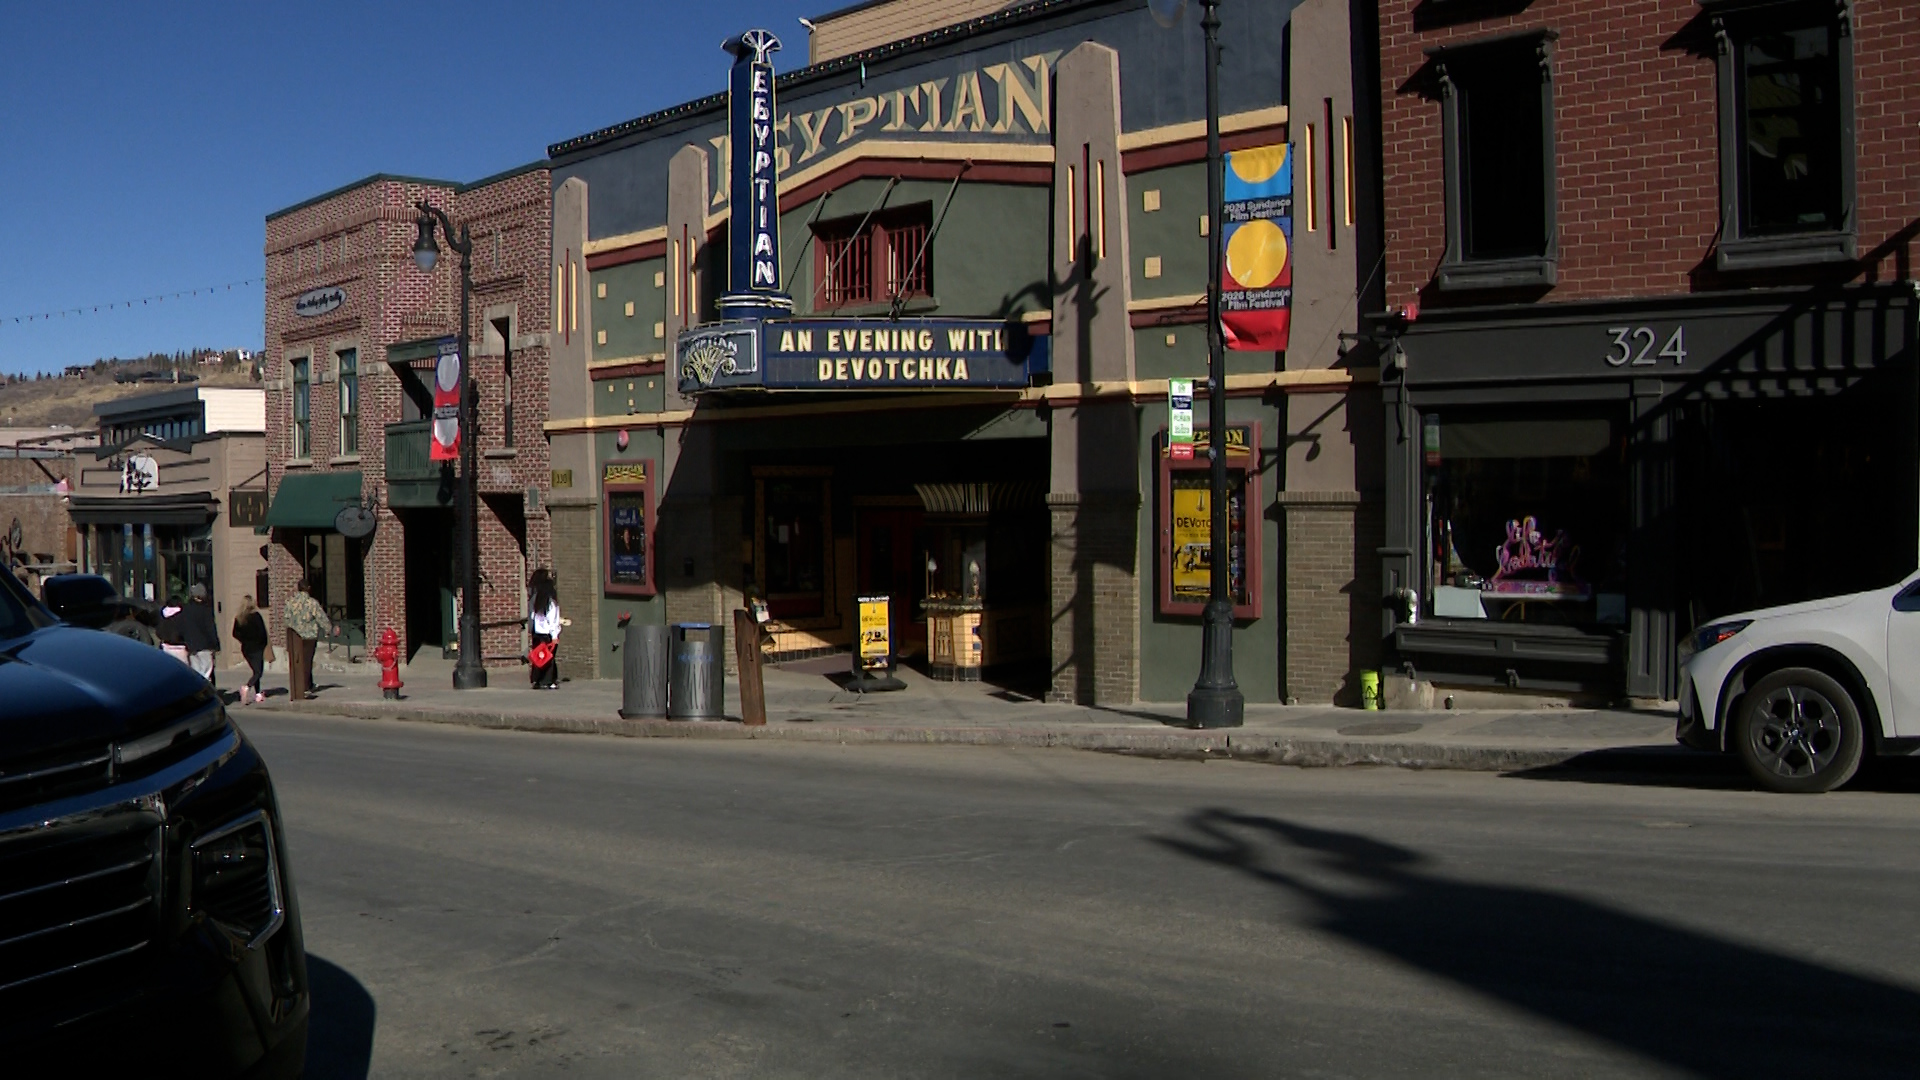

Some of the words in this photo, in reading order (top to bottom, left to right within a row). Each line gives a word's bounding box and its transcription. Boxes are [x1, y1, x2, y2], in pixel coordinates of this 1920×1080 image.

[753, 70, 775, 285] EGYPTIAN
[1224, 202, 1246, 214] 2026
[1247, 198, 1292, 212] Sundance
[1230, 211, 1249, 221] Film
[1250, 207, 1284, 219] Festival
[1222, 292, 1244, 302] 2026
[1246, 289, 1291, 300] Sundance
[1228, 301, 1248, 310] Film
[1249, 297, 1285, 308] Festival
[779, 329, 812, 353] AN
[827, 328, 934, 353] EVENING
[1605, 324, 1687, 367] 324
[818, 357, 969, 382] DEVOTCHKA
